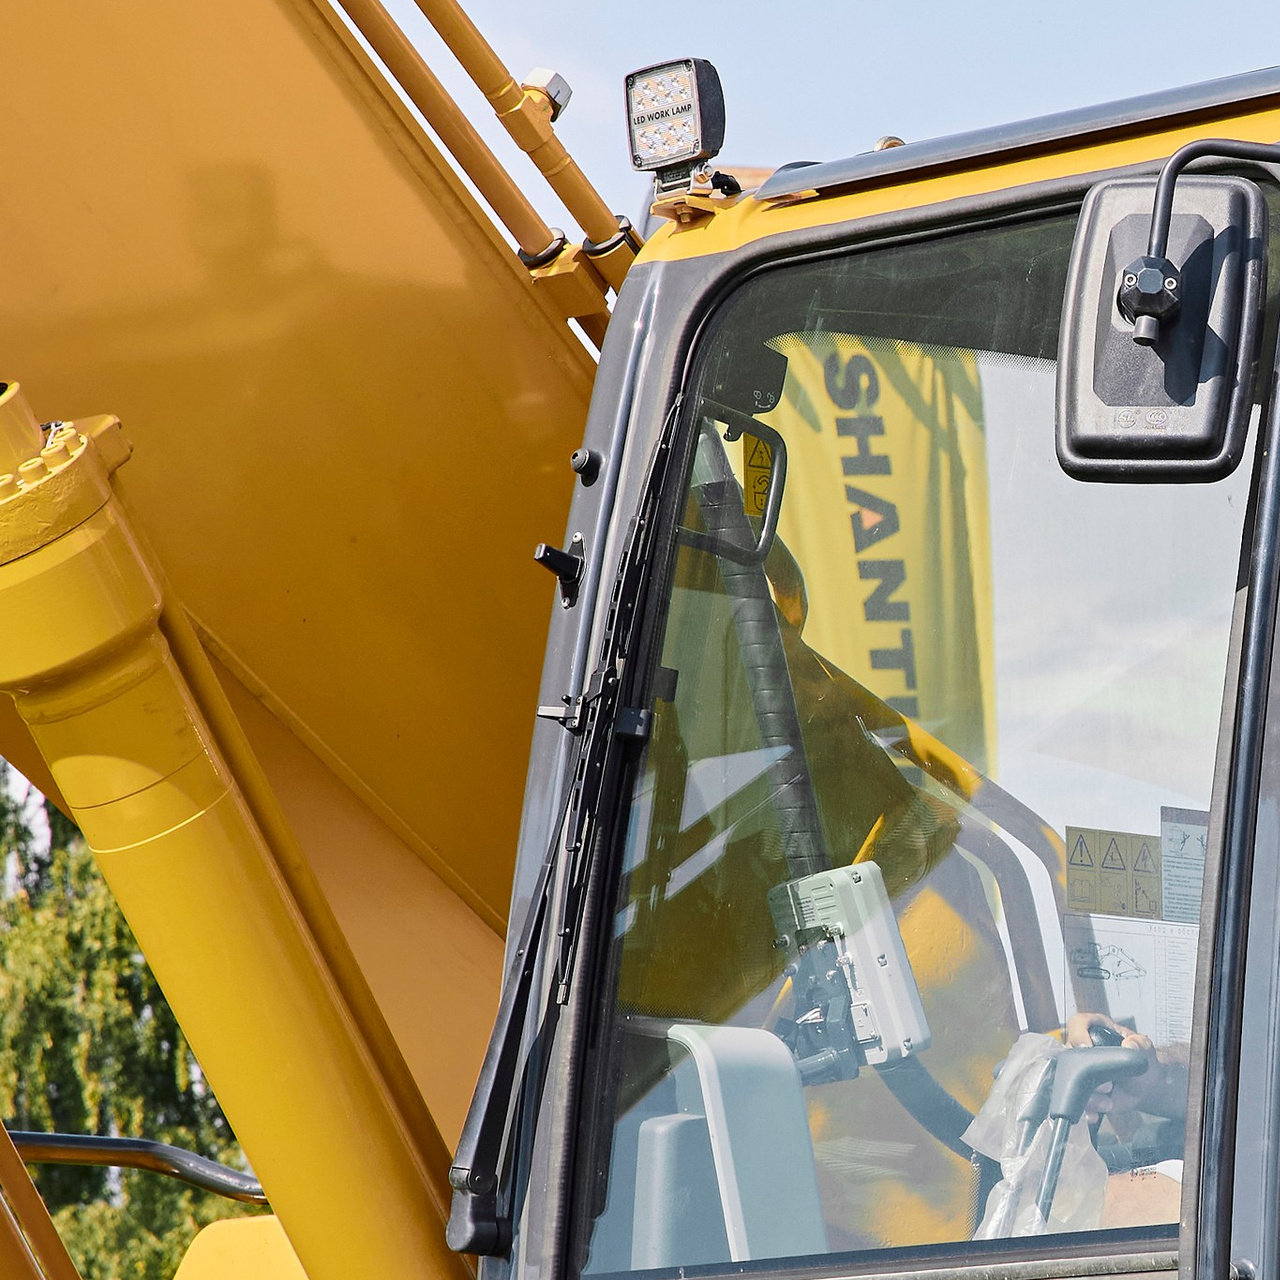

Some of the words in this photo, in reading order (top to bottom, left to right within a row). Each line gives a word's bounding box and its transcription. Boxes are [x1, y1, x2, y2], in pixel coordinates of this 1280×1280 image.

[633, 115, 645, 125] LED
[646, 109, 670, 122] WORK
[671, 104, 692, 117] LAMP
[824, 351, 919, 719] SHANT
